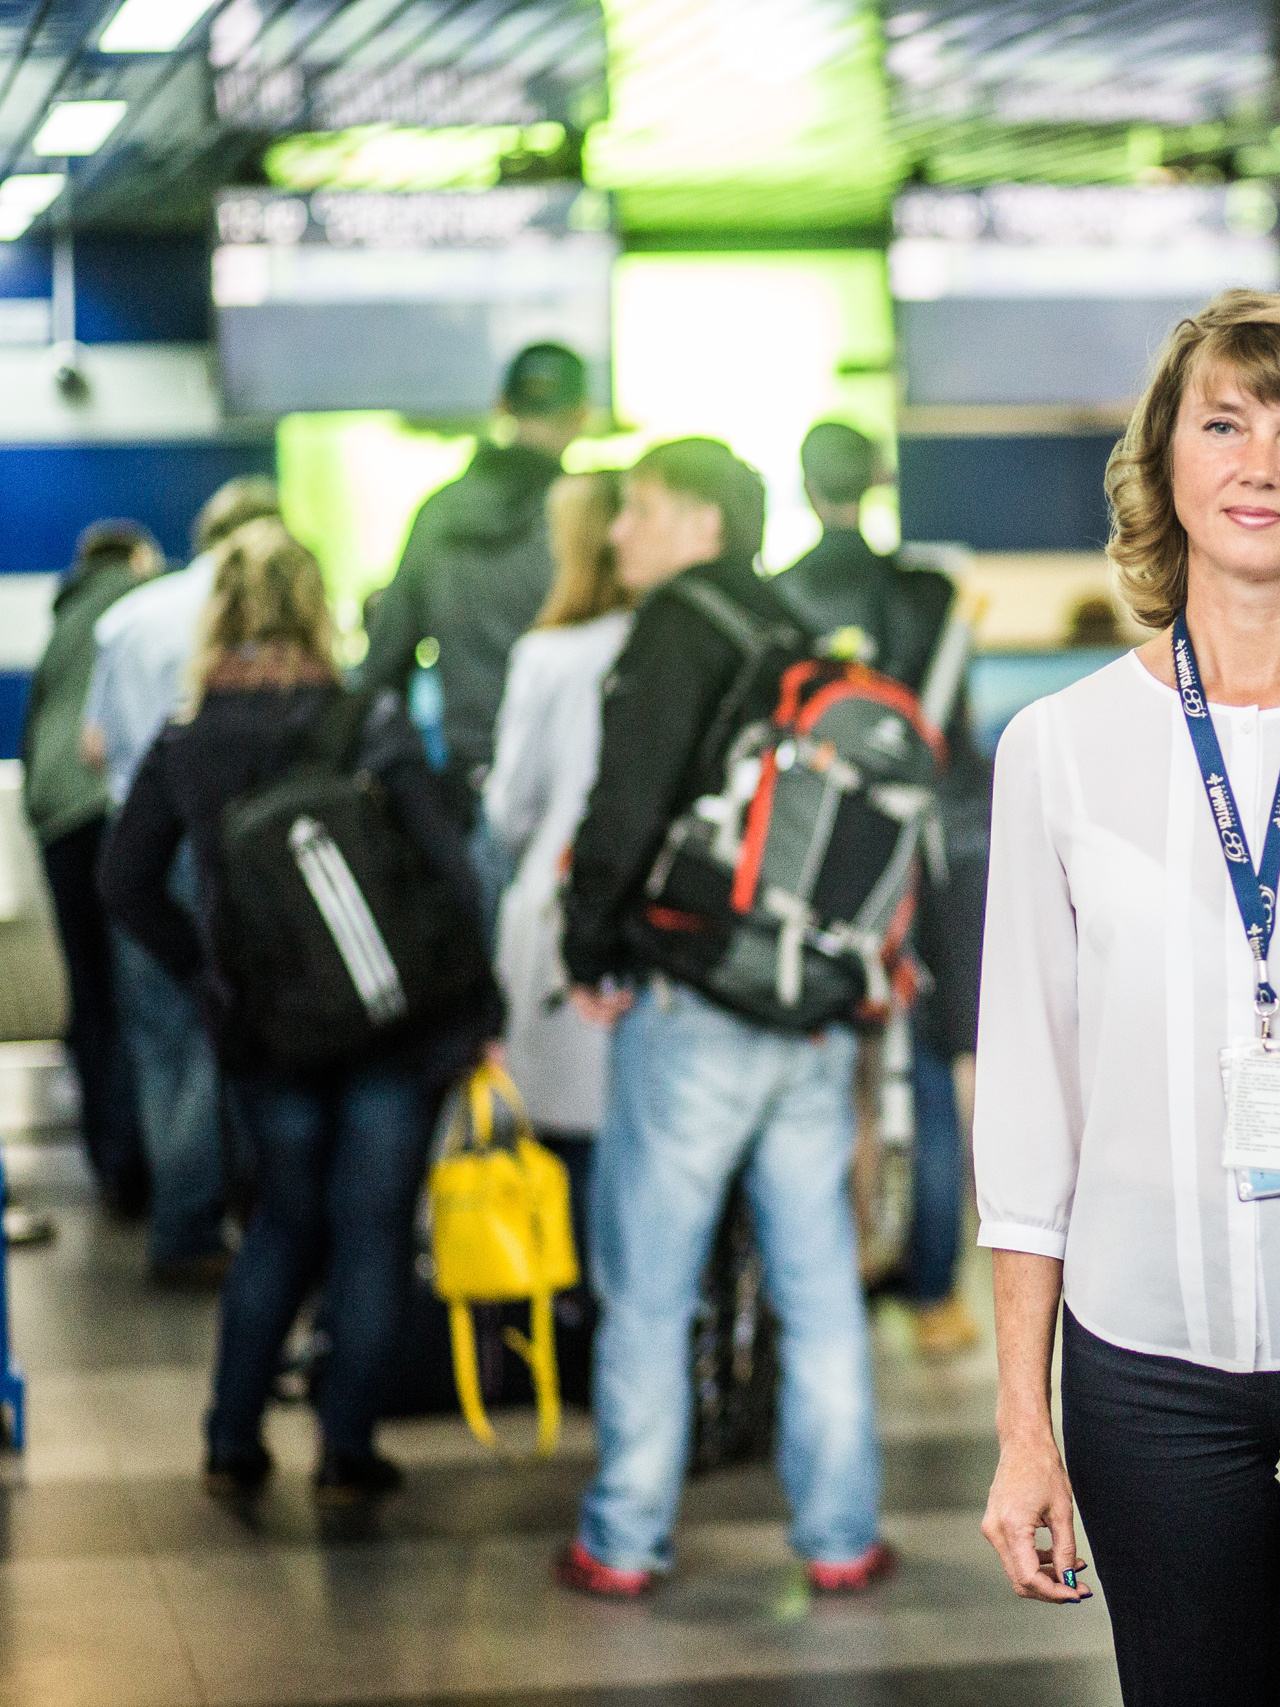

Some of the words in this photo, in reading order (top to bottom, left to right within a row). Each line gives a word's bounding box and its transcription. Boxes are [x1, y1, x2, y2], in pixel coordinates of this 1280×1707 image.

[1182, 688, 1206, 714] 85
[1209, 785, 1233, 830] ИРКУТСК
[1222, 830, 1248, 857] 85
